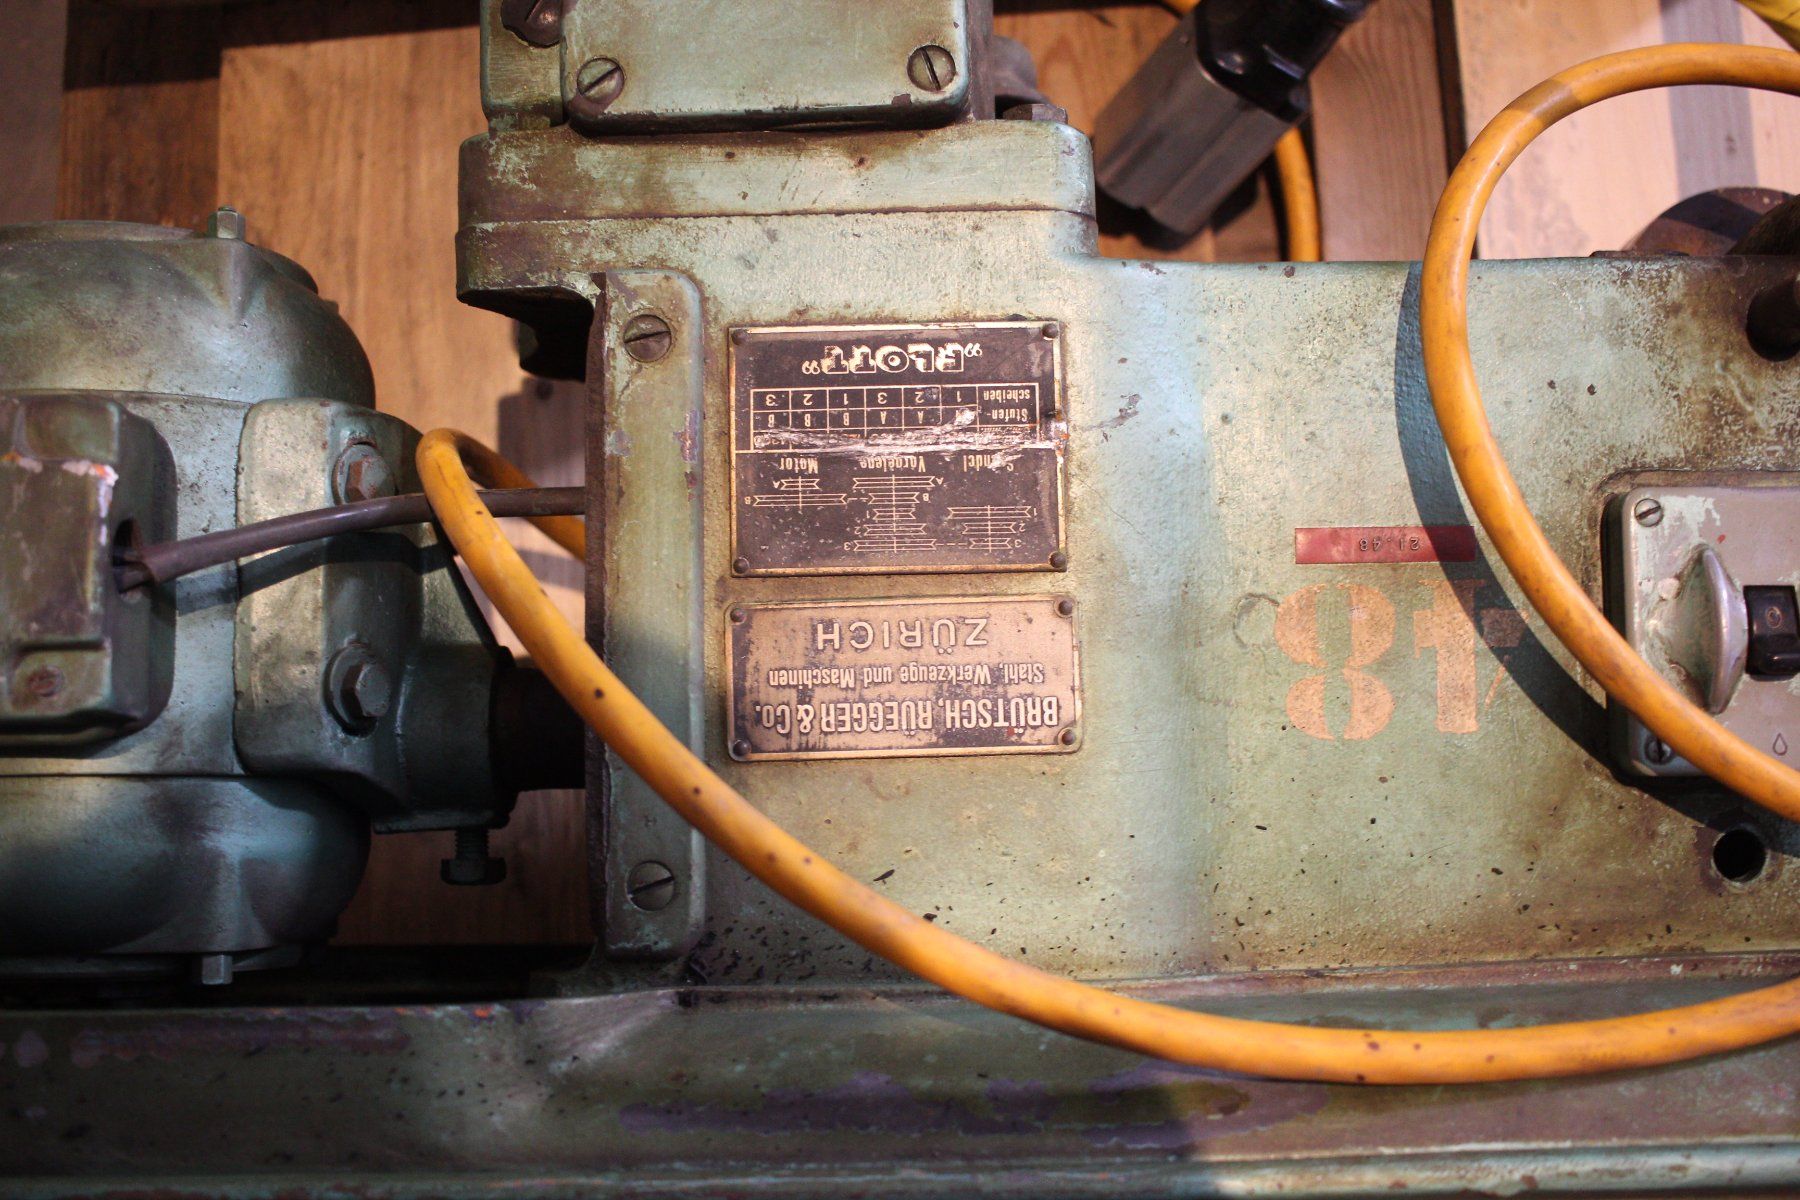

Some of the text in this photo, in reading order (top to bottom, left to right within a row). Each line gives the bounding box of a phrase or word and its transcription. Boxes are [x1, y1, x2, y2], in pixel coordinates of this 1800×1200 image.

[766, 389, 1030, 406] scheiben 1 2 3 1 2 3
[768, 408, 1028, 428] Stufen- A A B B B
[779, 458, 818, 473] Motor
[744, 496, 751, 504] B
[854, 526, 861, 534] 2
[844, 542, 851, 550] 3
[1359, 536, 1420, 552] 21.48
[817, 618, 988, 654] ZÜRICH
[768, 662, 1044, 690] Stahl, Werkzeuge und Maschinen
[756, 696, 1058, 736] BRÜTSCH, RÜEGGER & Co.
